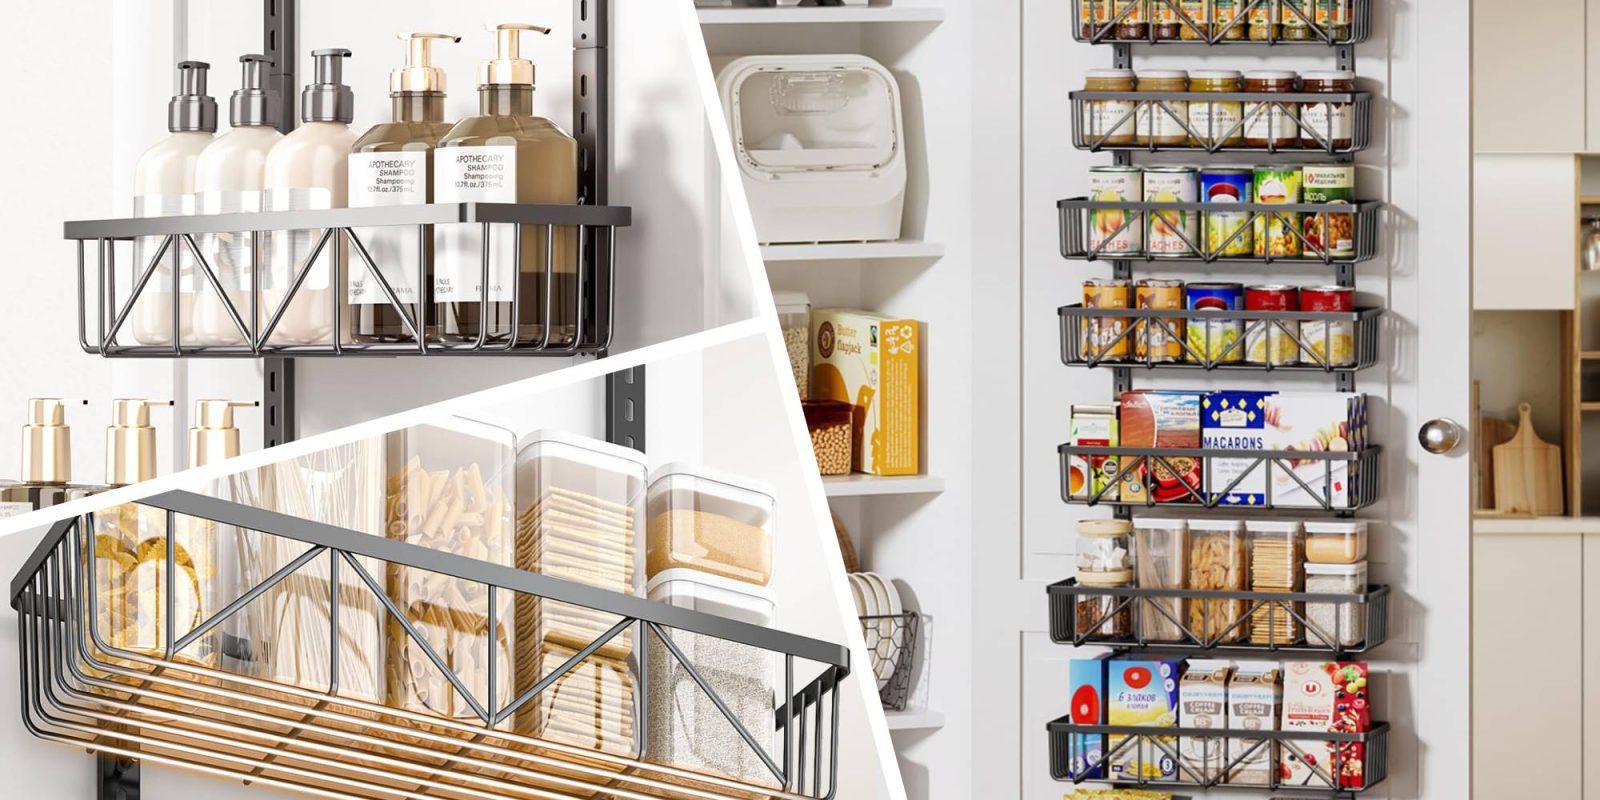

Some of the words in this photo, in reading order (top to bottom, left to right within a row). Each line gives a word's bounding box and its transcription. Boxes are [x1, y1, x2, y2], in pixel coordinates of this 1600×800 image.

[456, 154, 504, 164] APOTHECARY
[368, 160, 415, 169] APOTHECARY
[467, 164, 504, 172] SHAMPOO
[379, 169, 415, 177] SHAMPOO
[463, 173, 504, 181] Shampooing
[375, 177, 415, 186] Shampooing
[837, 323, 857, 338] Butter
[1203, 436, 1263, 449] MACARONS
[1118, 691, 1124, 702] 6
[1189, 701, 1215, 709] COFFEE
[1238, 703, 1264, 711] COFFEE
